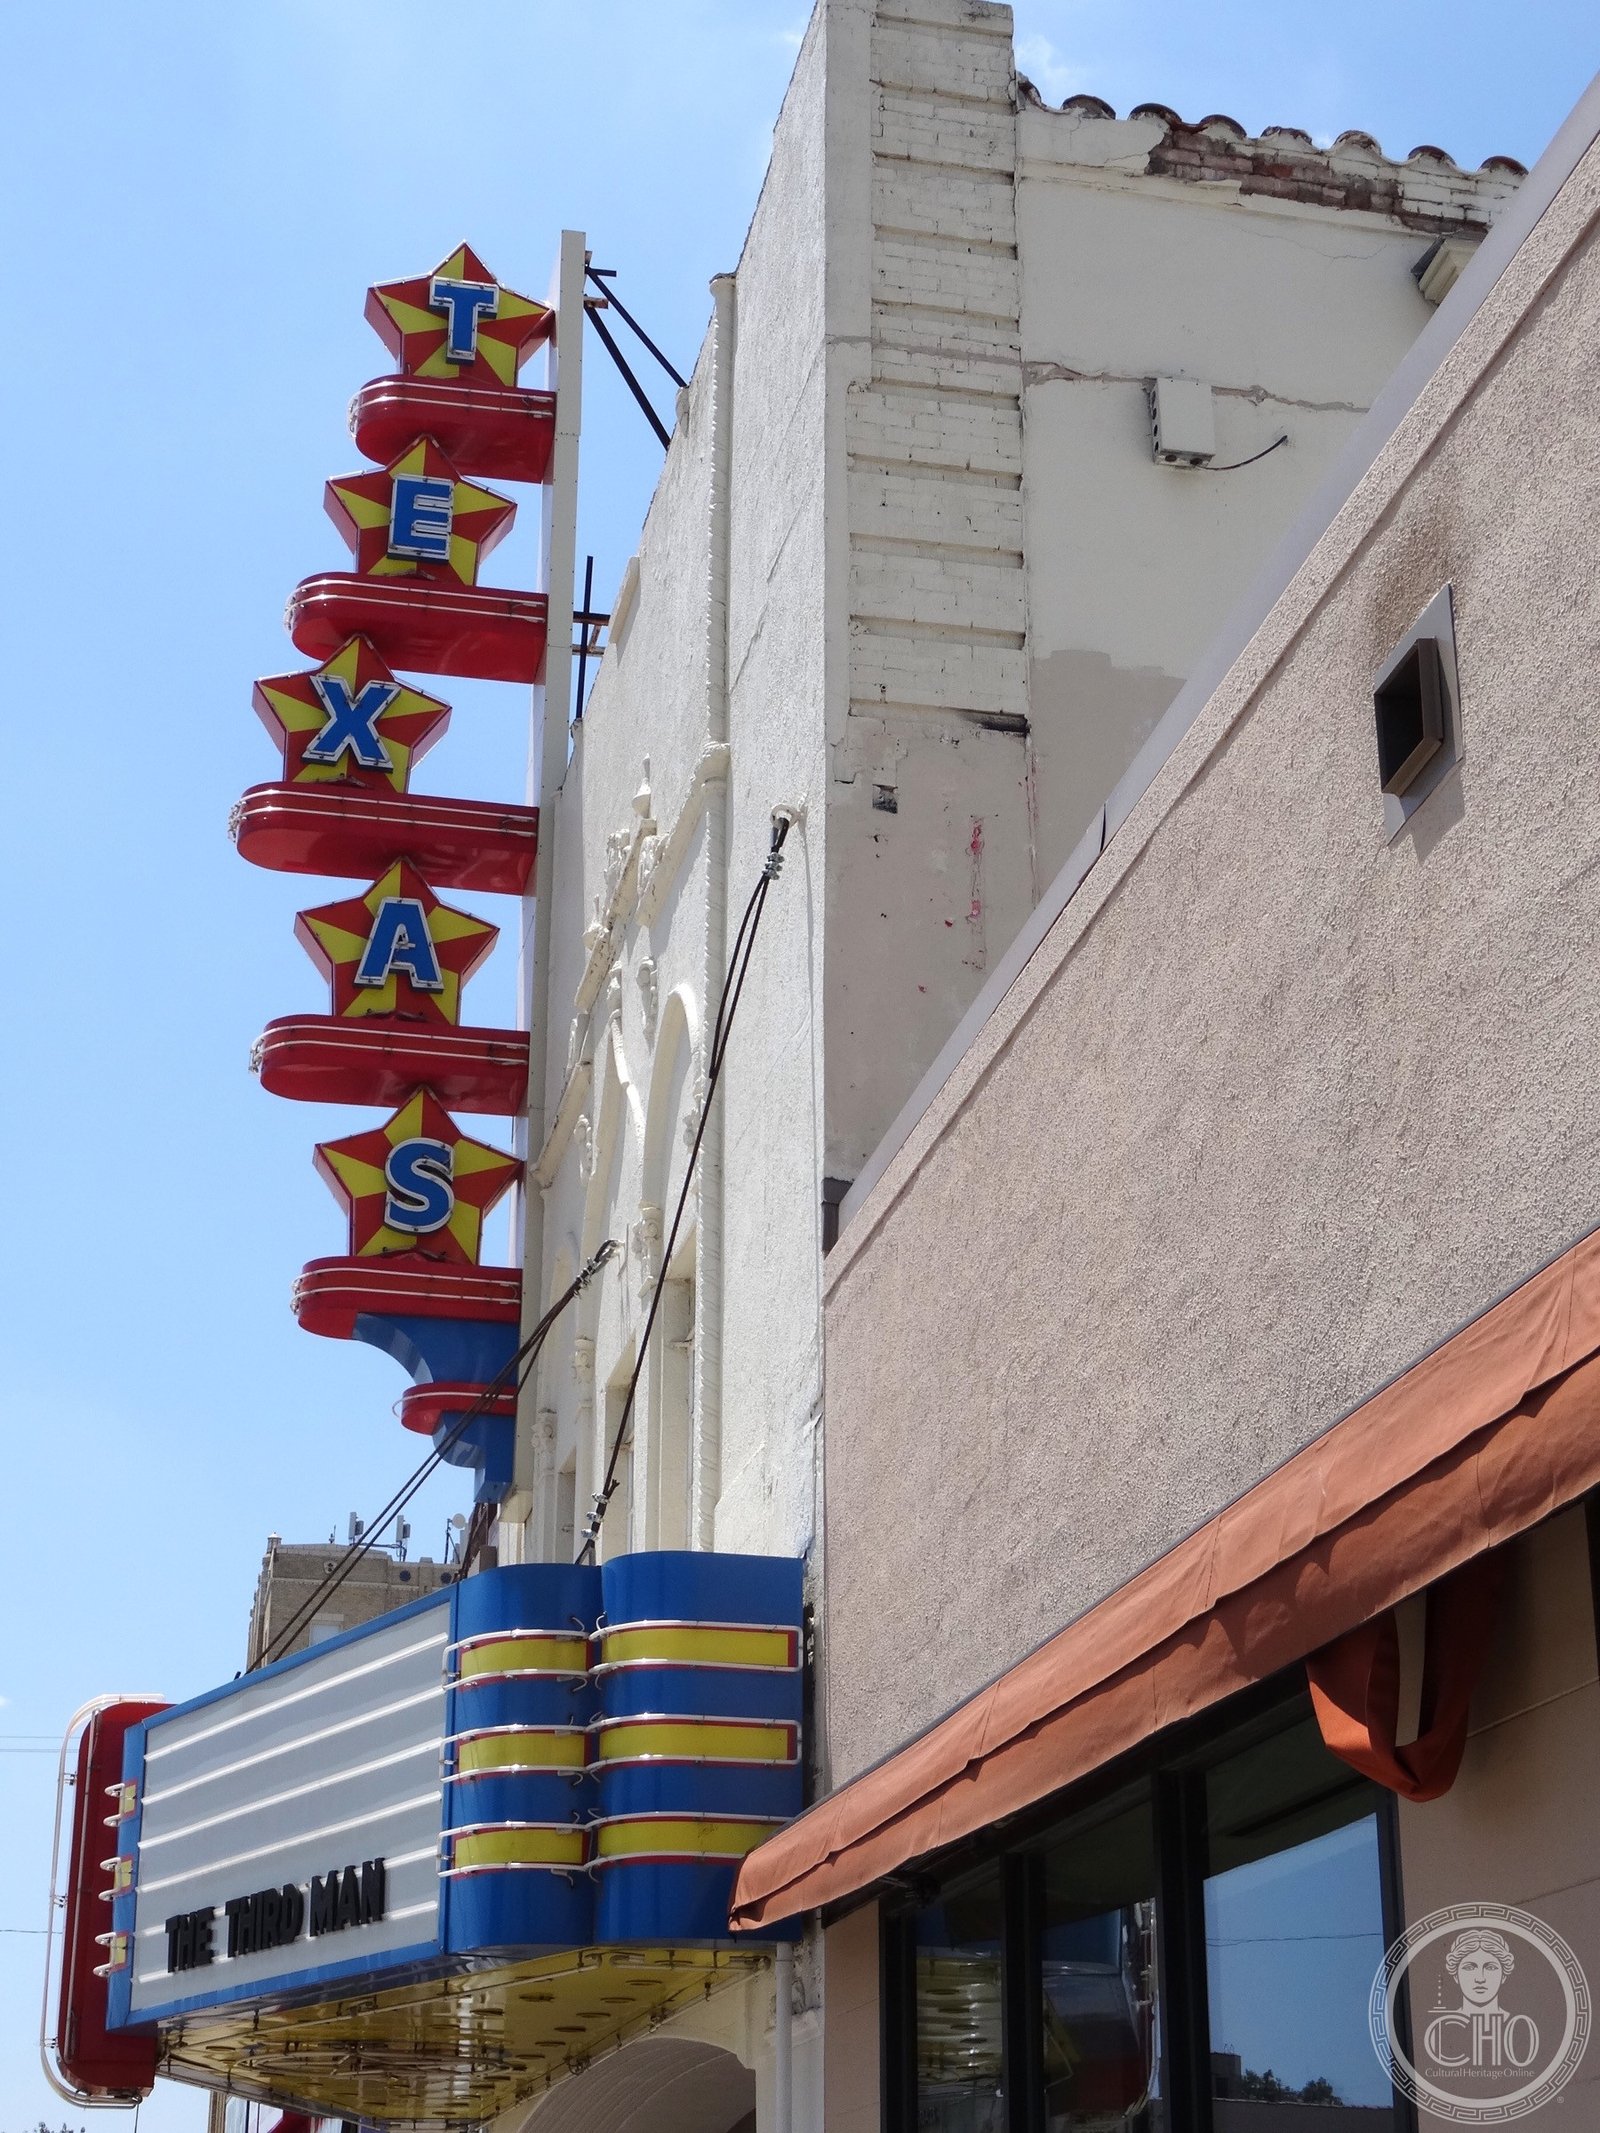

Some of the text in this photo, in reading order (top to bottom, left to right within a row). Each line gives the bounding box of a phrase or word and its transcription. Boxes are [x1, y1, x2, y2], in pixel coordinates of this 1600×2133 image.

[302, 277, 498, 1234] TEXAS
[165, 1857, 386, 1973] THE THIRD MAN
